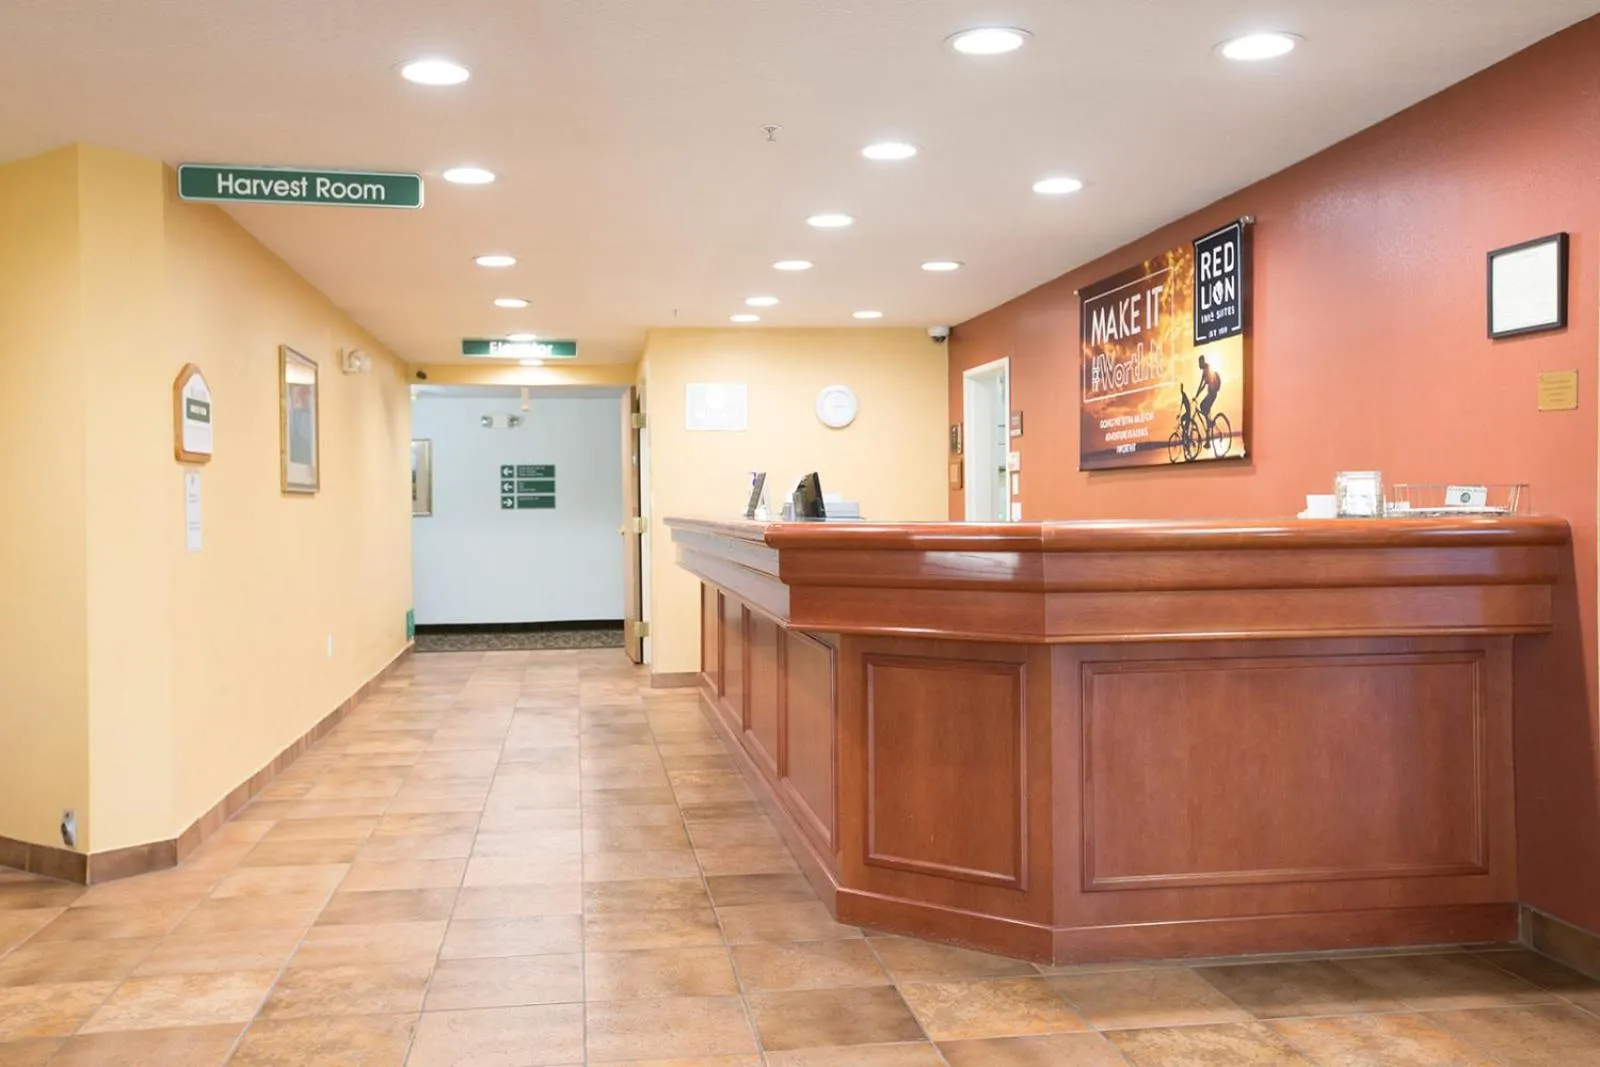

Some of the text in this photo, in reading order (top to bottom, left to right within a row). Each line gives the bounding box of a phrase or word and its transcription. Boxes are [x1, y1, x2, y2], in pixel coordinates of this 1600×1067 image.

[217, 173, 386, 200] Harvest Room
[1200, 241, 1235, 282] RED
[1200, 275, 1235, 310] LION
[1091, 285, 1164, 348] MAKE IT
